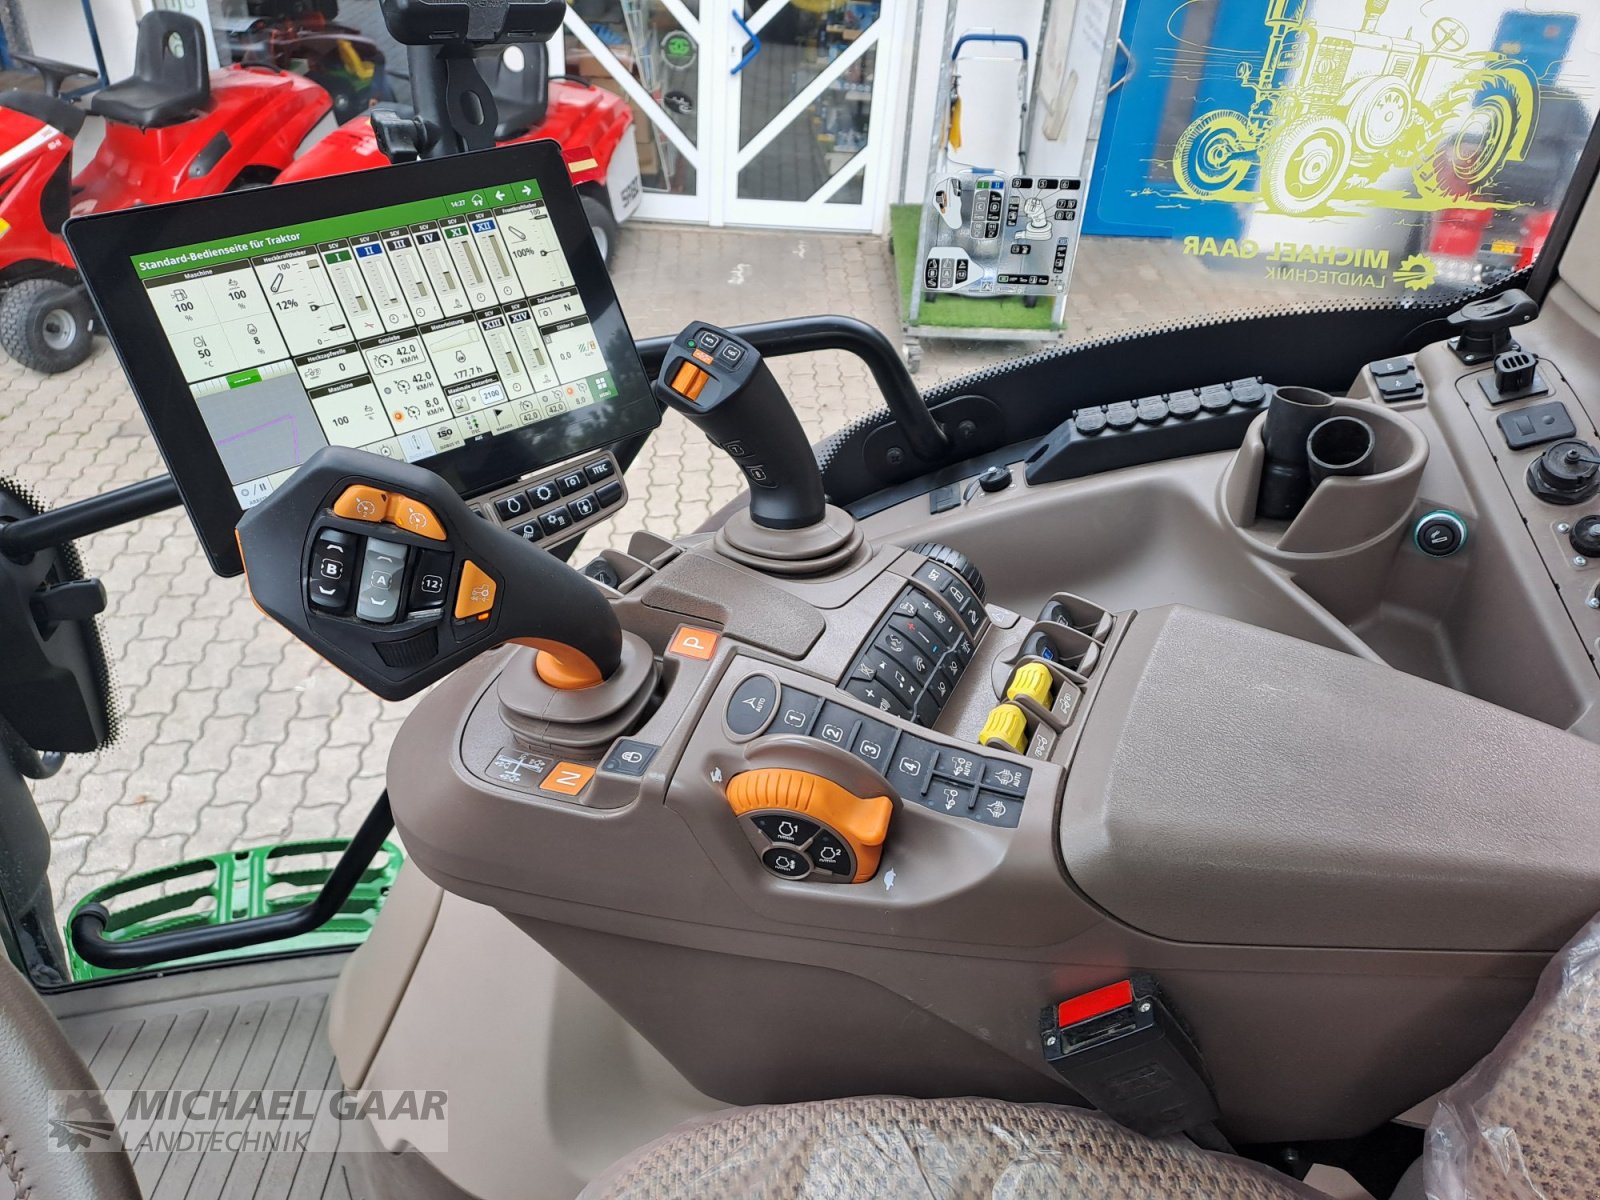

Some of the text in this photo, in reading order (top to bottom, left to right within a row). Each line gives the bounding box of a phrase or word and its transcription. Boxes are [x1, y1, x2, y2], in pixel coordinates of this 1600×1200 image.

[452, 228, 462, 236] XI
[477, 222, 492, 232] XII
[422, 234, 433, 242] IV
[394, 240, 407, 248] III
[139, 232, 300, 272] Standard-Bedienseite für Traktor
[365, 246, 374, 255] II
[512, 248, 535, 258] 100%
[184, 269, 213, 279] Maschine
[228, 290, 247, 301] 100
[175, 302, 194, 313] 100
[276, 299, 298, 311] 12%
[563, 303, 572, 312] N
[511, 312, 528, 322] XIV
[484, 319, 502, 330] XIII
[253, 337, 260, 345] 8
[198, 349, 211, 359] 50
[400, 355, 419, 364] KM/H
[339, 363, 345, 371] 0
[476, 365, 483, 374] h
[328, 383, 354, 393] Maschine
[416, 382, 434, 391] KM/H
[483, 390, 500, 400] 2100
[426, 407, 445, 416] KM/H
[332, 416, 349, 427] 100
[437, 428, 453, 439] ISO
[327, 564, 337, 575] B
[928, 568, 941, 582] SET
[377, 576, 386, 585] A
[426, 580, 438, 589] 12
[682, 636, 705, 650] P
[755, 697, 766, 713] AUTO
[789, 714, 801, 722] 1
[826, 728, 840, 739] 2
[864, 744, 877, 755] 3
[903, 761, 916, 772] 4
[963, 761, 973, 777] AUTO
[556, 770, 578, 786] N
[1012, 771, 1022, 788] AUTO
